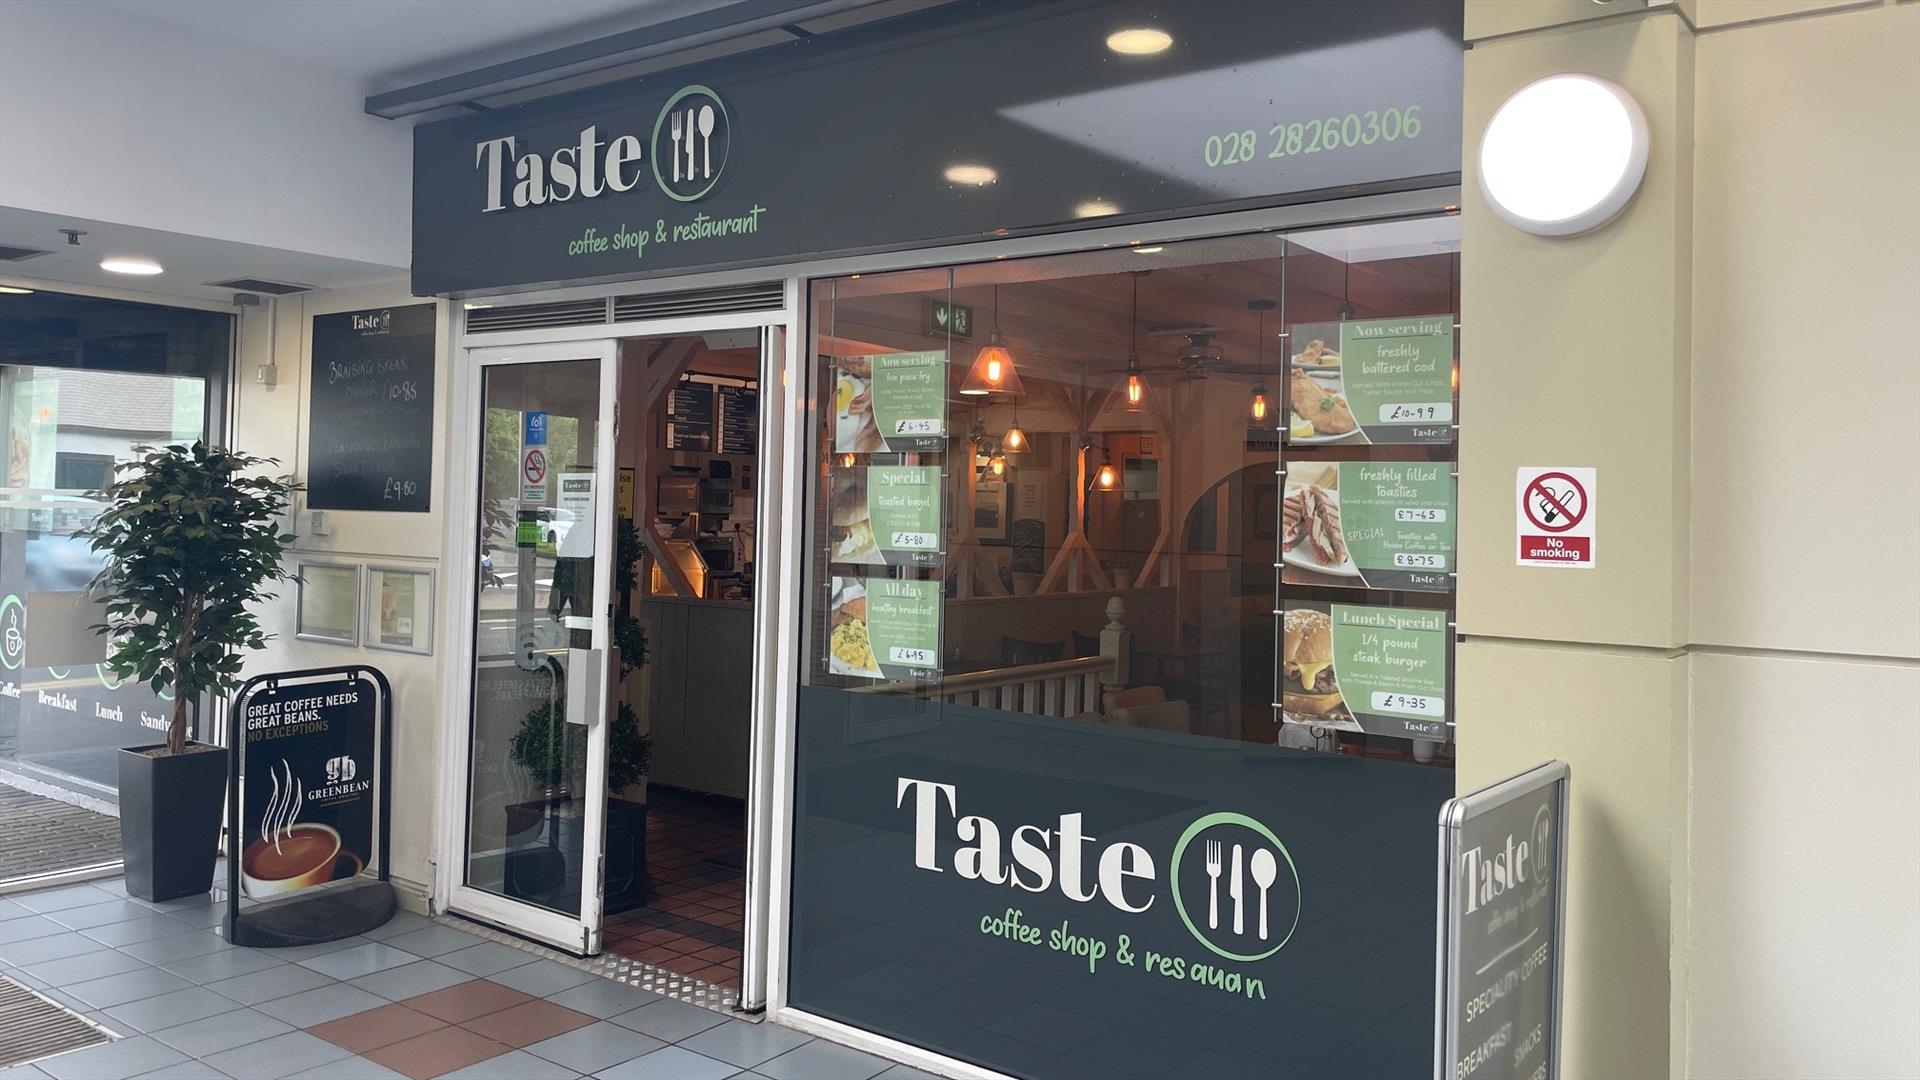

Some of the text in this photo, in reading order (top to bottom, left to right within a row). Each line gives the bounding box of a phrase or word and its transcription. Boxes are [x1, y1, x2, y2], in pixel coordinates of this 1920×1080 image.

[1204, 104, 1422, 167] 028 28260306
[476, 125, 642, 213] Taste
[569, 204, 767, 258] coffee shop & restaurant
[352, 314, 379, 329] Taste
[1355, 321, 1443, 338] Now serving
[902, 354, 936, 368] serving
[1377, 343, 1420, 361] freshly
[1362, 358, 1435, 374] battered cod
[1412, 428, 1437, 437] Taste
[882, 471, 926, 487] Special
[1360, 467, 1437, 486] freshly filled
[1375, 485, 1418, 498] toasties
[907, 495, 931, 512] bagel
[1347, 527, 1385, 542] SPECIAL
[1546, 538, 1563, 548] No
[912, 553, 928, 561] Taste
[1530, 548, 1580, 561] smoking
[1409, 574, 1435, 584] Taste
[902, 583, 922, 600] day
[1343, 611, 1440, 631] Lunch Special
[1362, 634, 1419, 651] 1/4 pound
[1352, 649, 1427, 672] steak burger
[0, 681, 21, 699] Coffee
[38, 690, 78, 712] Breakfast
[248, 692, 358, 718] GREAT COFFEE NEEDS
[96, 702, 123, 722] Lunch
[248, 709, 321, 730] GREAT BEANS.
[248, 720, 329, 742] NO EXCEPTIONS
[1404, 721, 1429, 732] Taste
[308, 780, 370, 800] GREENBEAN
[897, 777, 1156, 914] Taste
[1461, 833, 1529, 916] Taste
[980, 907, 1042, 945] coffee
[1048, 920, 1107, 974] shop
[1116, 934, 1135, 967] &
[1466, 942, 1548, 1023] SPECIALITY COFFEE
[1457, 1021, 1512, 1080] BREAKFAST
